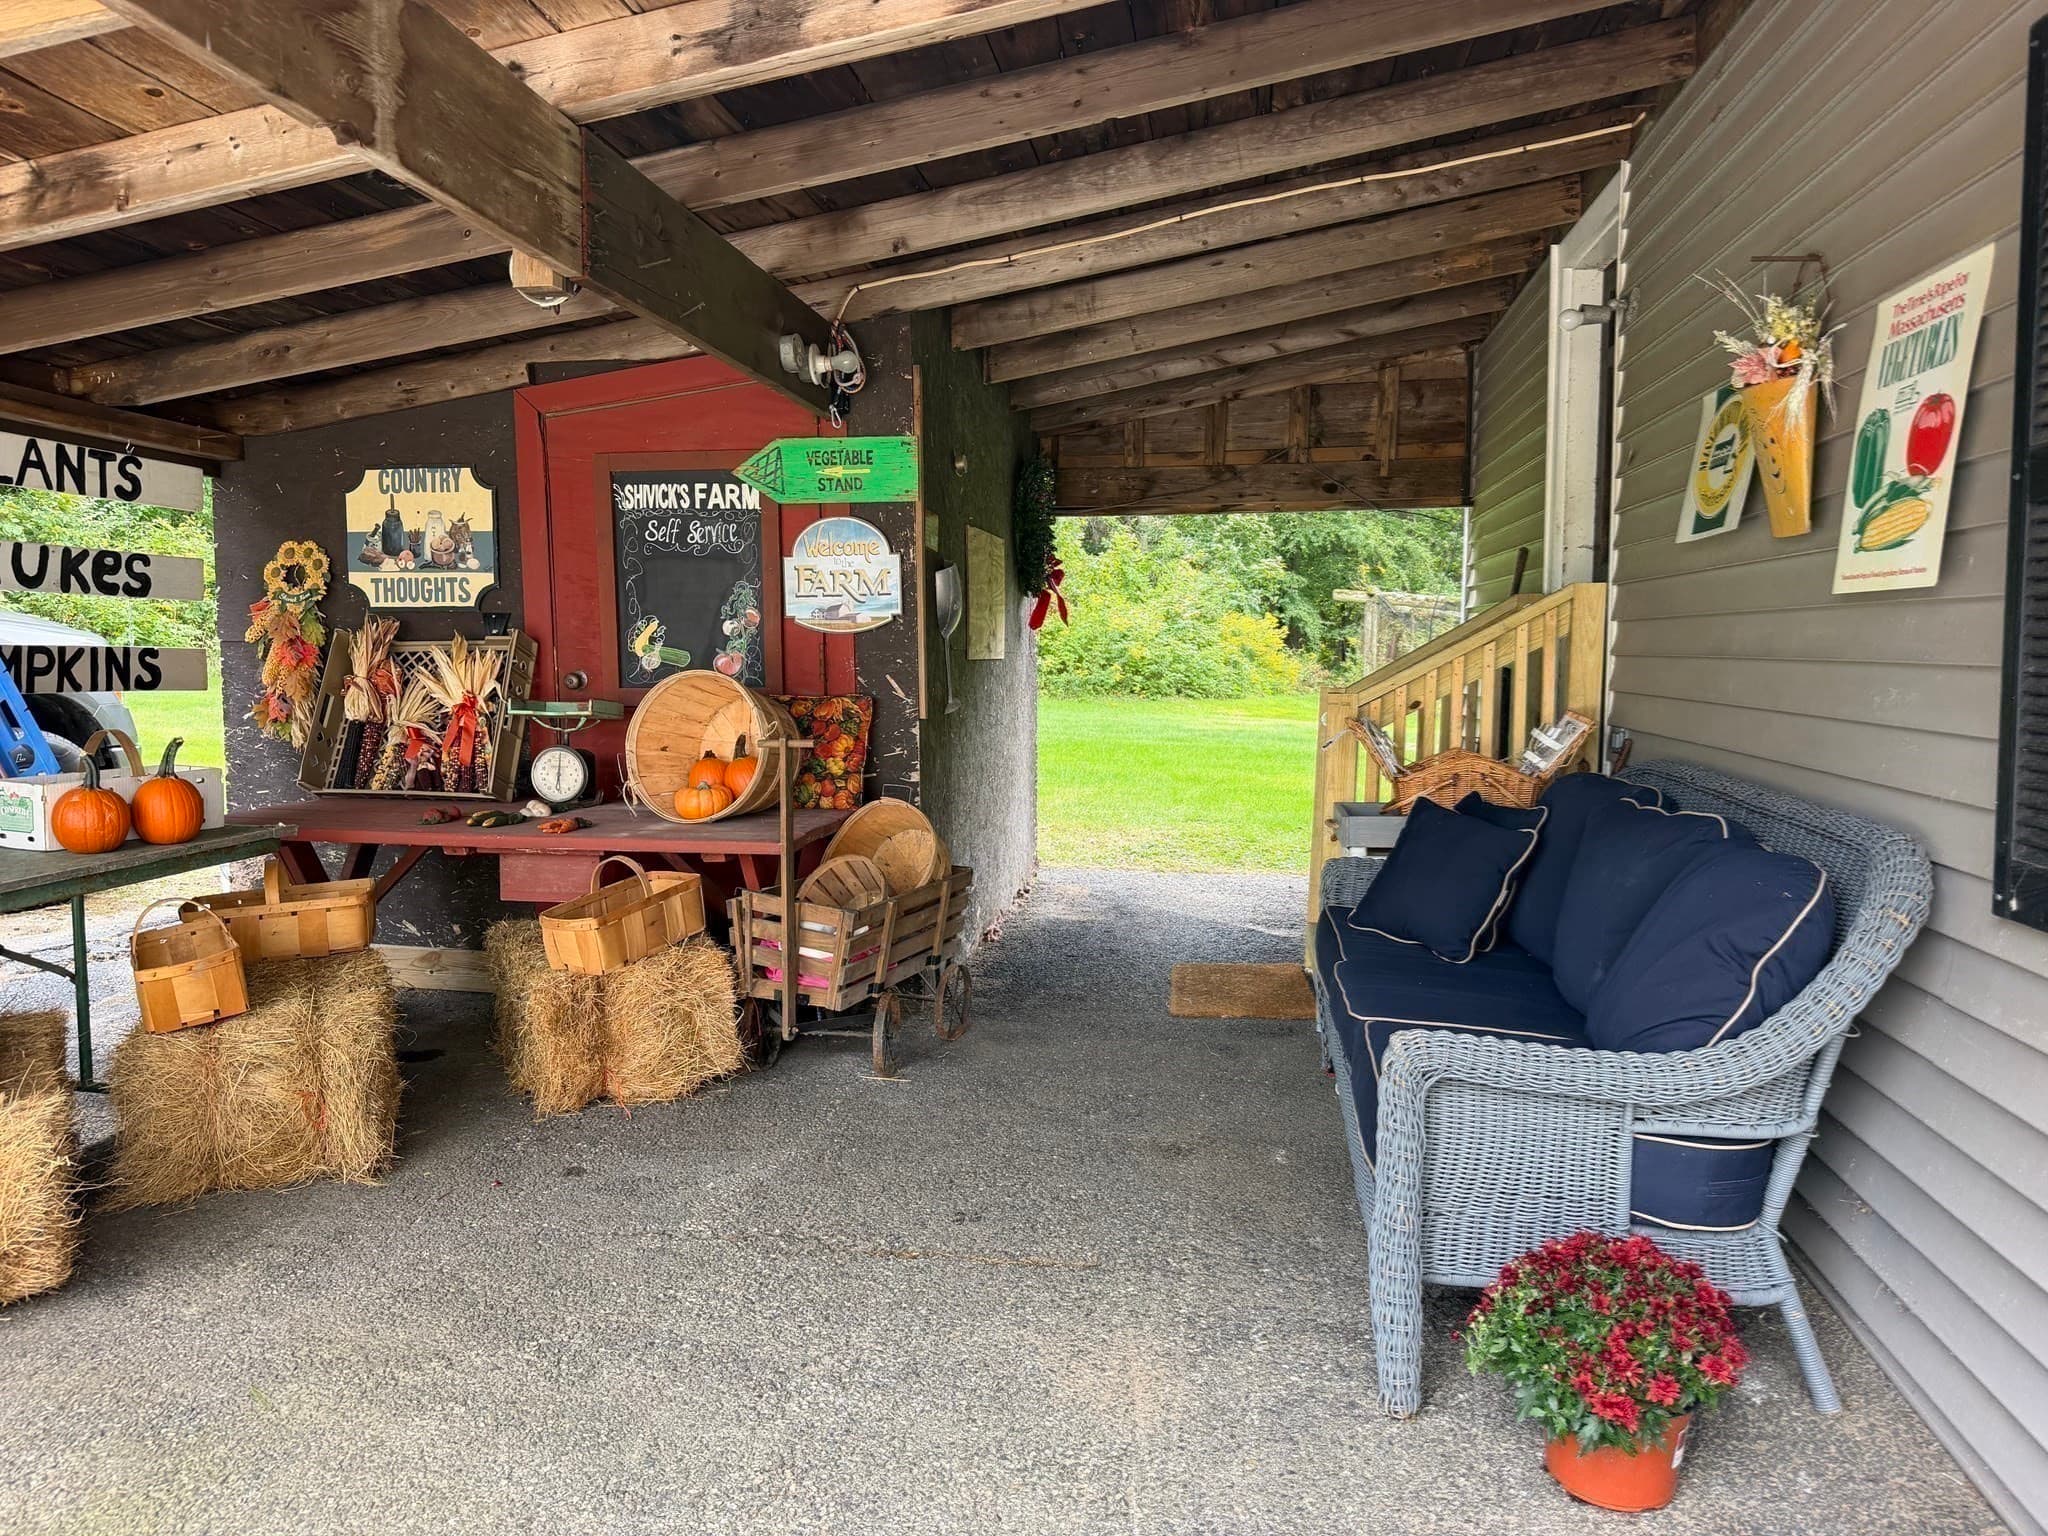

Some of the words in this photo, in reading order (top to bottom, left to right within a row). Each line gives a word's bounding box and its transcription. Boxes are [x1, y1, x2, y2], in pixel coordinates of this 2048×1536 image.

[806, 448, 874, 466] VEGETABLE
[378, 468, 462, 495] COUNTRY
[818, 477, 863, 492] STAND
[694, 483, 760, 510] FARM
[645, 518, 681, 544] Self
[687, 519, 738, 544] Service
[803, 525, 880, 563] Welcome
[371, 577, 471, 603] THOUGHTS
[794, 564, 891, 603] FARM
